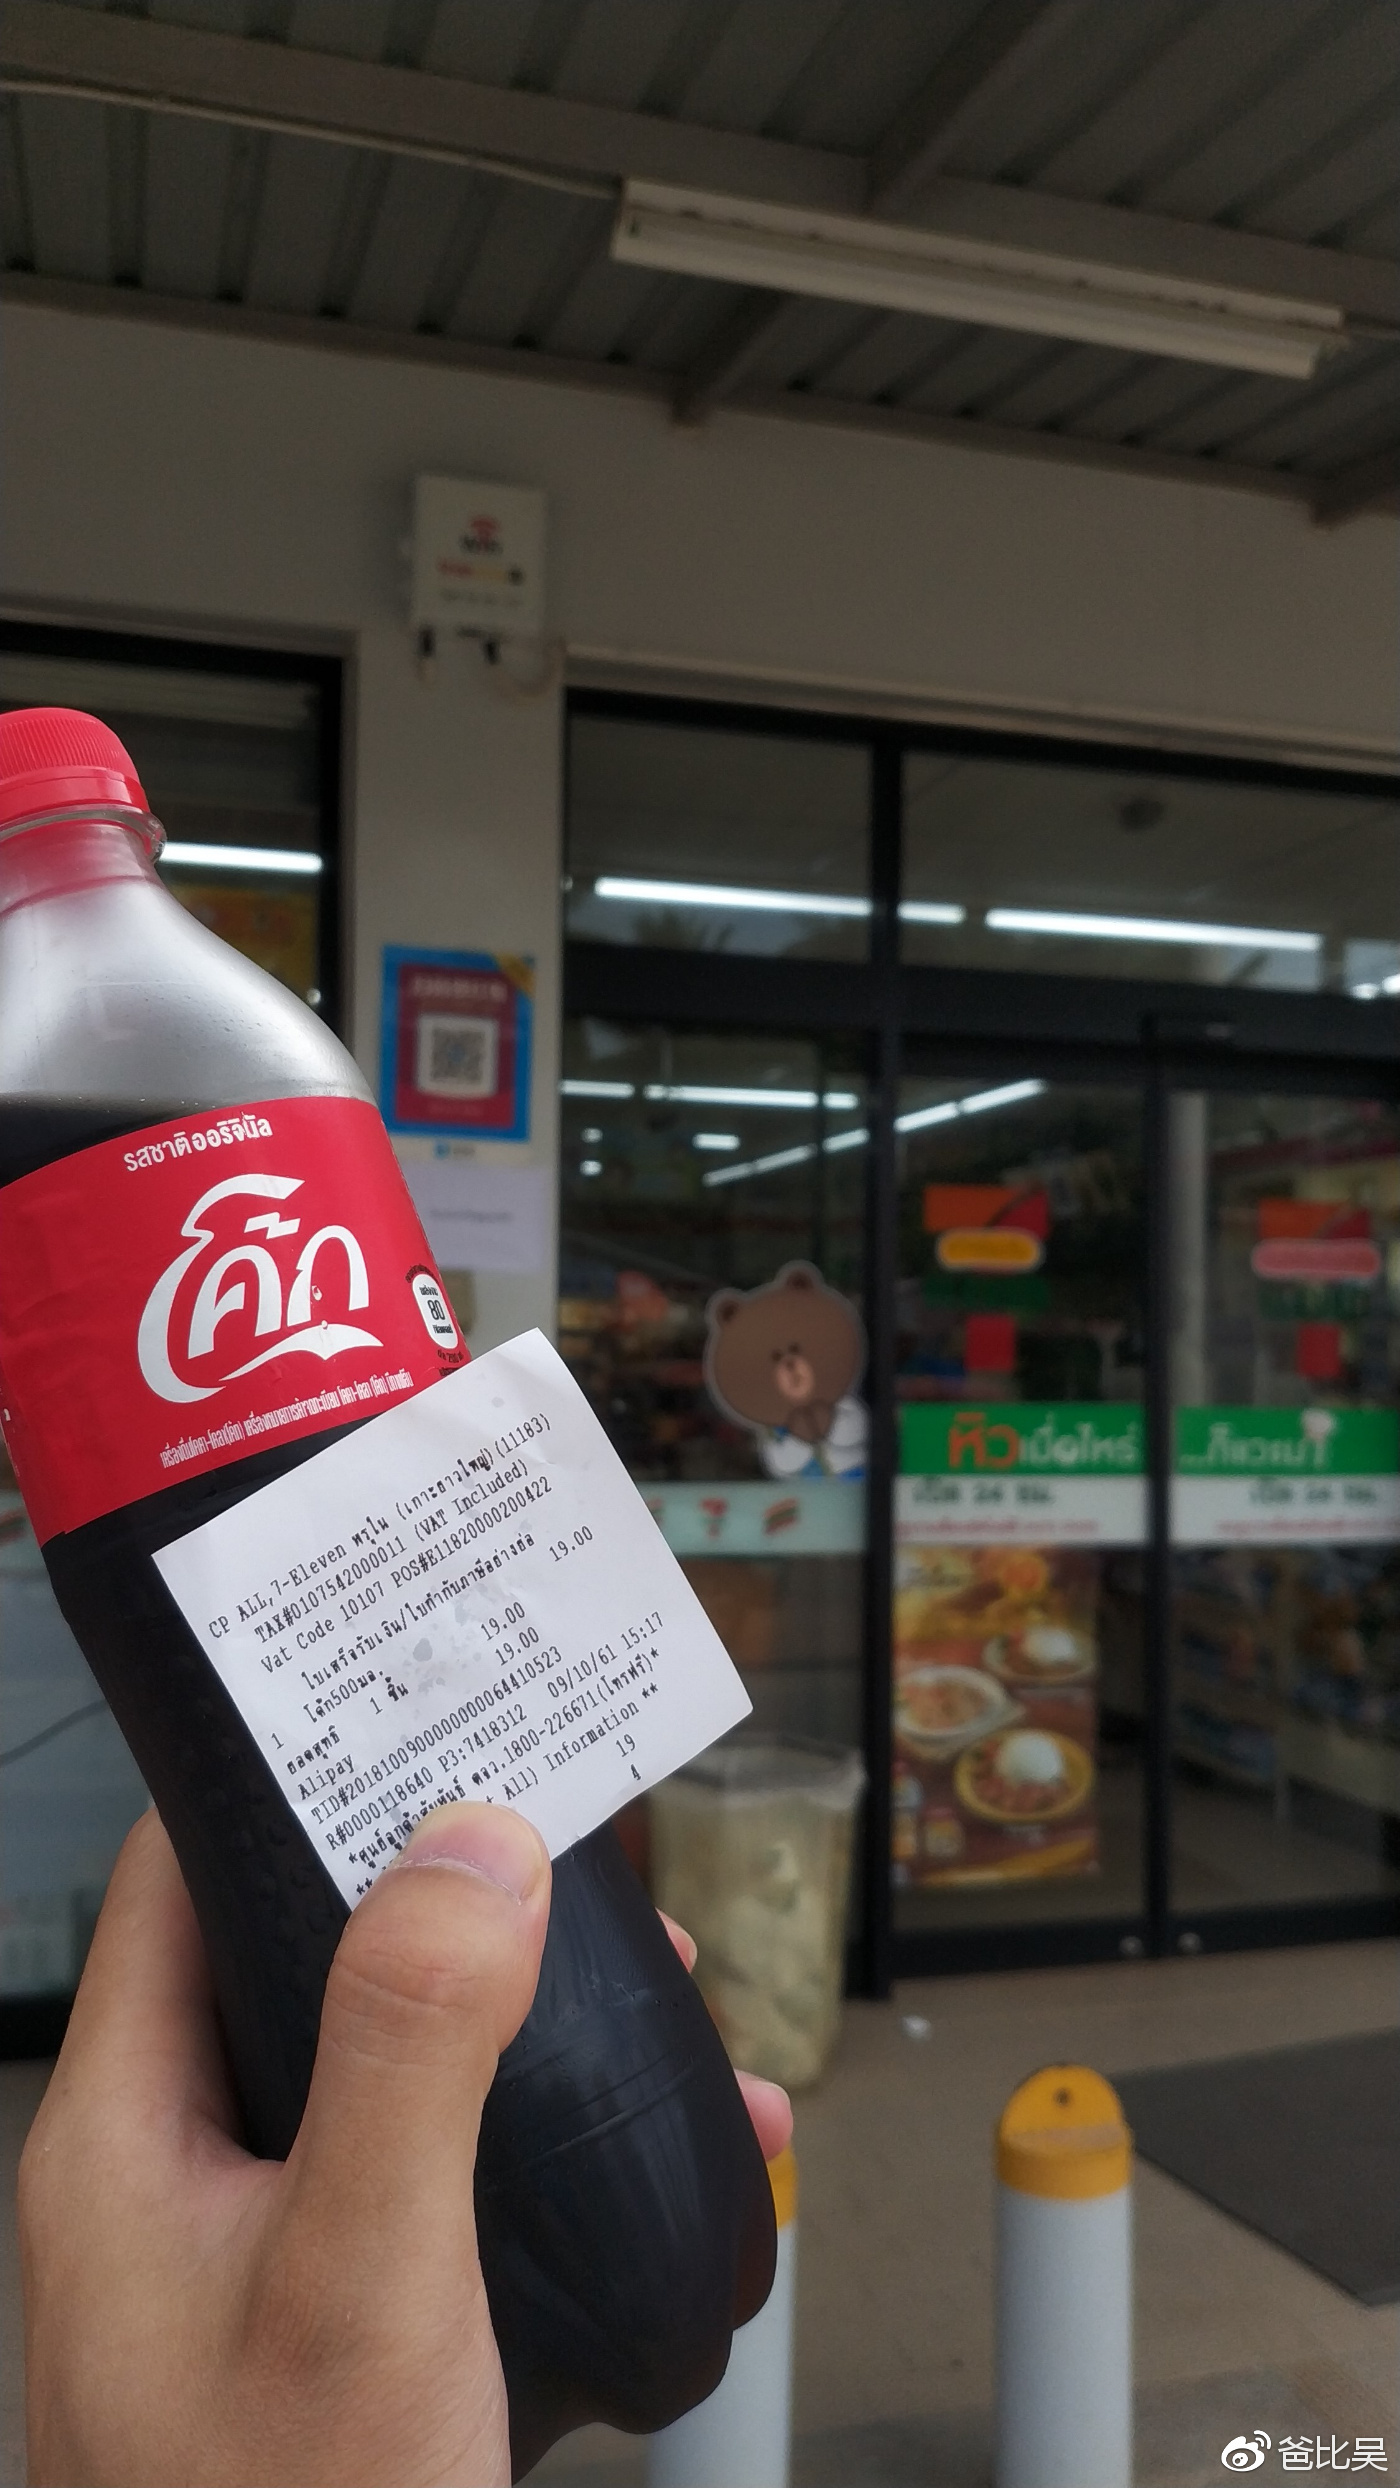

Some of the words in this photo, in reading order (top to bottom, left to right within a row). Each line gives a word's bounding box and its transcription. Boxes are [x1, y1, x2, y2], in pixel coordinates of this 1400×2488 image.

[427, 1299, 446, 1321] 80
[253, 1535, 407, 1643] TAX#0107542000011
[414, 1508, 448, 1541] (VAT
[451, 1458, 527, 1515] Included)
[260, 1646, 292, 1672] Vat
[296, 1619, 334, 1649] Code
[339, 1580, 384, 1621] 10107
[390, 1476, 551, 1588] POS#E11820000200422
[208, 1615, 230, 1638] CP
[271, 1732, 284, 1749] 1
[549, 1525, 592, 1561] 19.00
[369, 1697, 382, 1714] 1
[480, 1601, 525, 1640] 19.00
[297, 1754, 354, 1800] Alipay
[495, 1626, 539, 1665] 19.00
[325, 1766, 433, 1850] R#0000118640
[437, 1703, 527, 1773] P3:7418312
[547, 1643, 617, 1697] 09/10/61
[620, 1611, 662, 1649] 15:17
[501, 1766, 538, 1800] All)
[542, 1701, 639, 1771] Information
[615, 1733, 635, 1757] 19
[630, 1763, 641, 1780] 4
